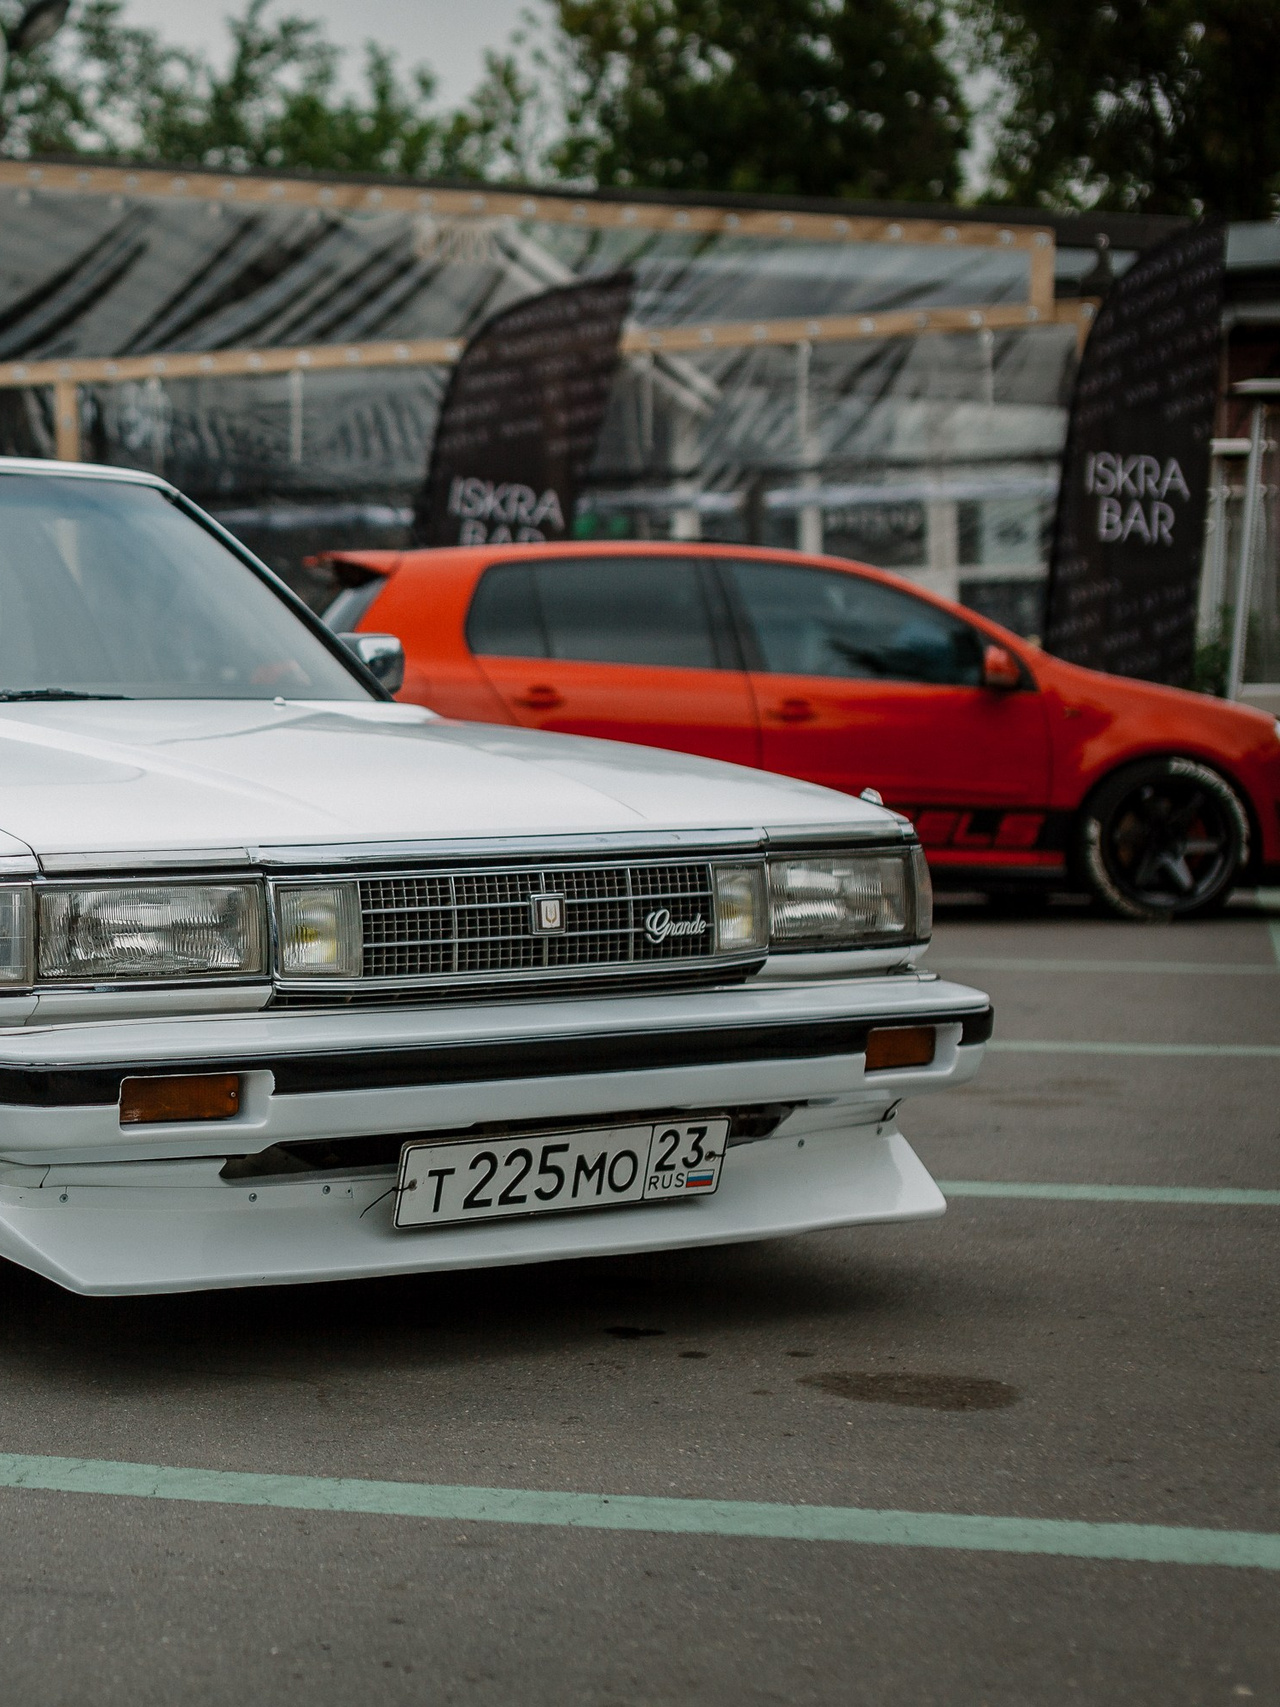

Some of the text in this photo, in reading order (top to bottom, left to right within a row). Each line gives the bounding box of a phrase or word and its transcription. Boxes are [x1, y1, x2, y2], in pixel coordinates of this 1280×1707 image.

[1086, 450, 1191, 501] ISKRA
[448, 477, 565, 532] ISKRA
[1099, 496, 1175, 546] BAR
[645, 908, 707, 944] Grande
[654, 1126, 708, 1172] 23
[647, 1172, 685, 1191] RUS
